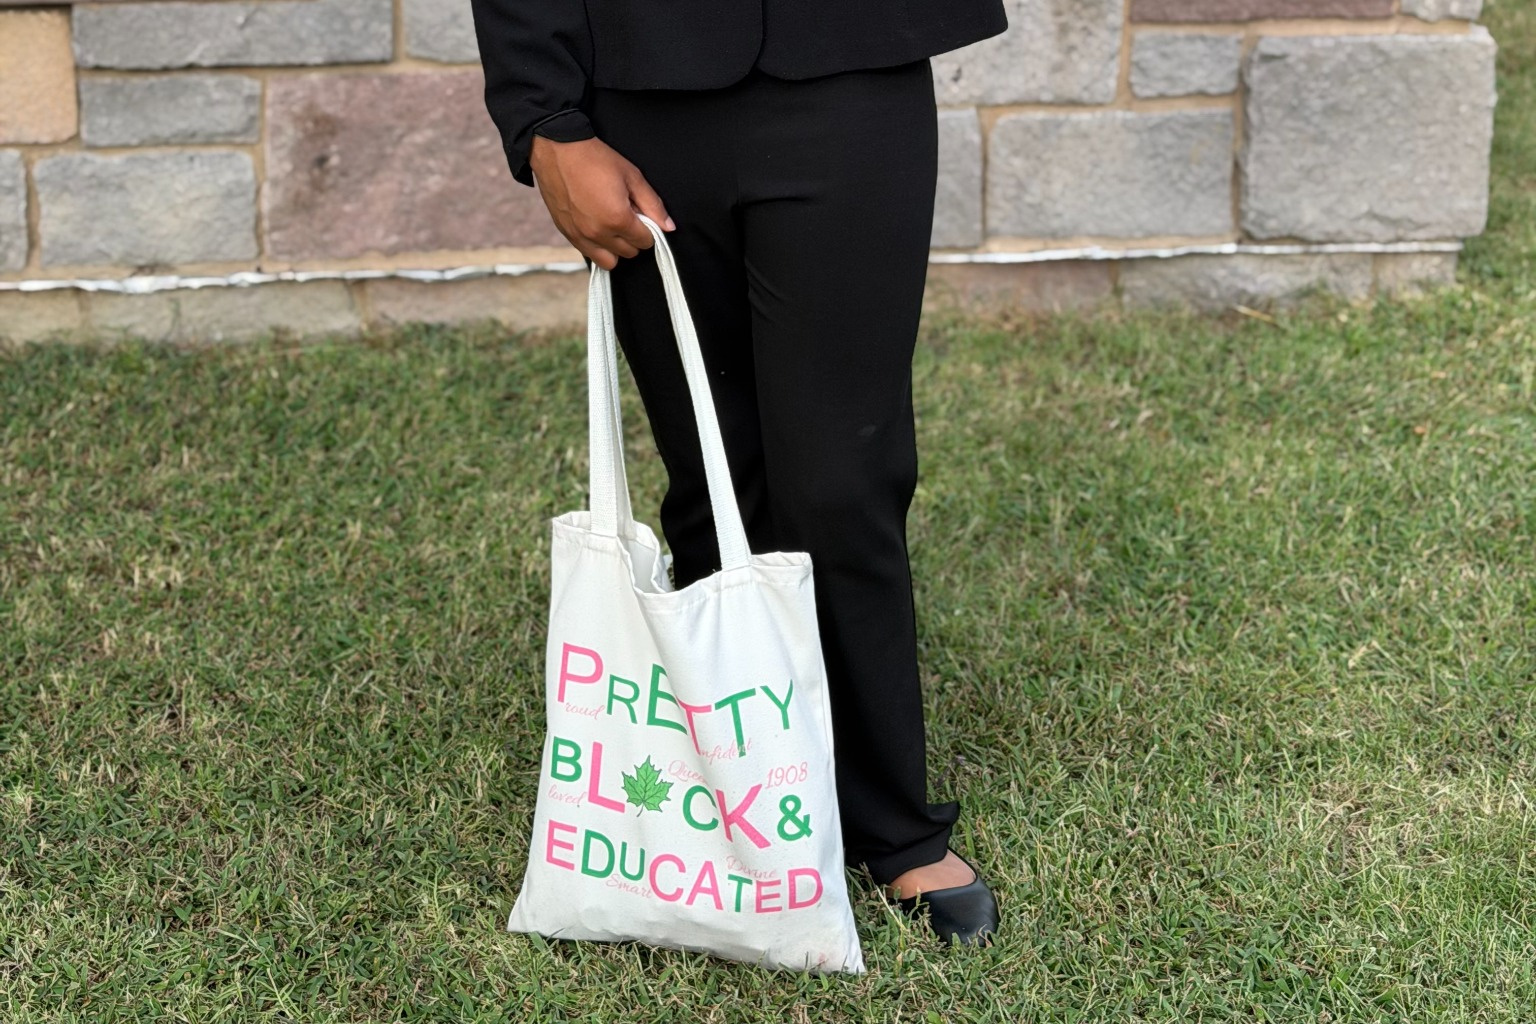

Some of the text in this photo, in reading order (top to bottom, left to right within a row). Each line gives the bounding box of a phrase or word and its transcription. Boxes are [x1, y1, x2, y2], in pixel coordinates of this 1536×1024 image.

[557, 641, 793, 758] PRETTY
[765, 762, 808, 789] 1908
[777, 794, 813, 841] &
[546, 819, 824, 914] EDUCATED
